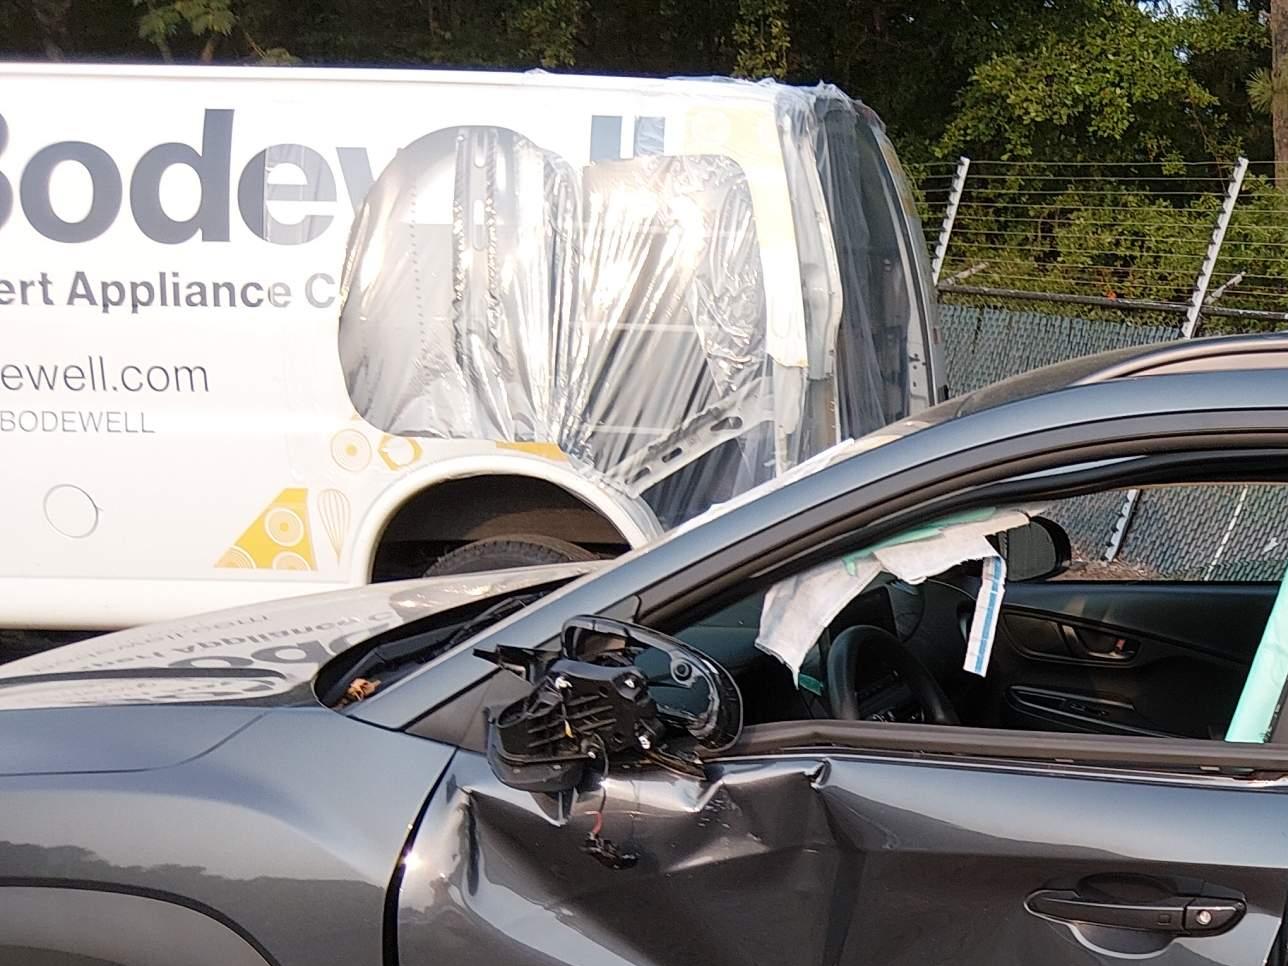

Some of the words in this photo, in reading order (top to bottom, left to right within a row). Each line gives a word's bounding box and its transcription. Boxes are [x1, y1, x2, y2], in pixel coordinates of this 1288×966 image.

[66, 271, 292, 313] Appliance
[0, 355, 209, 392] ewell.com
[0, 410, 155, 433] BODEWELL
